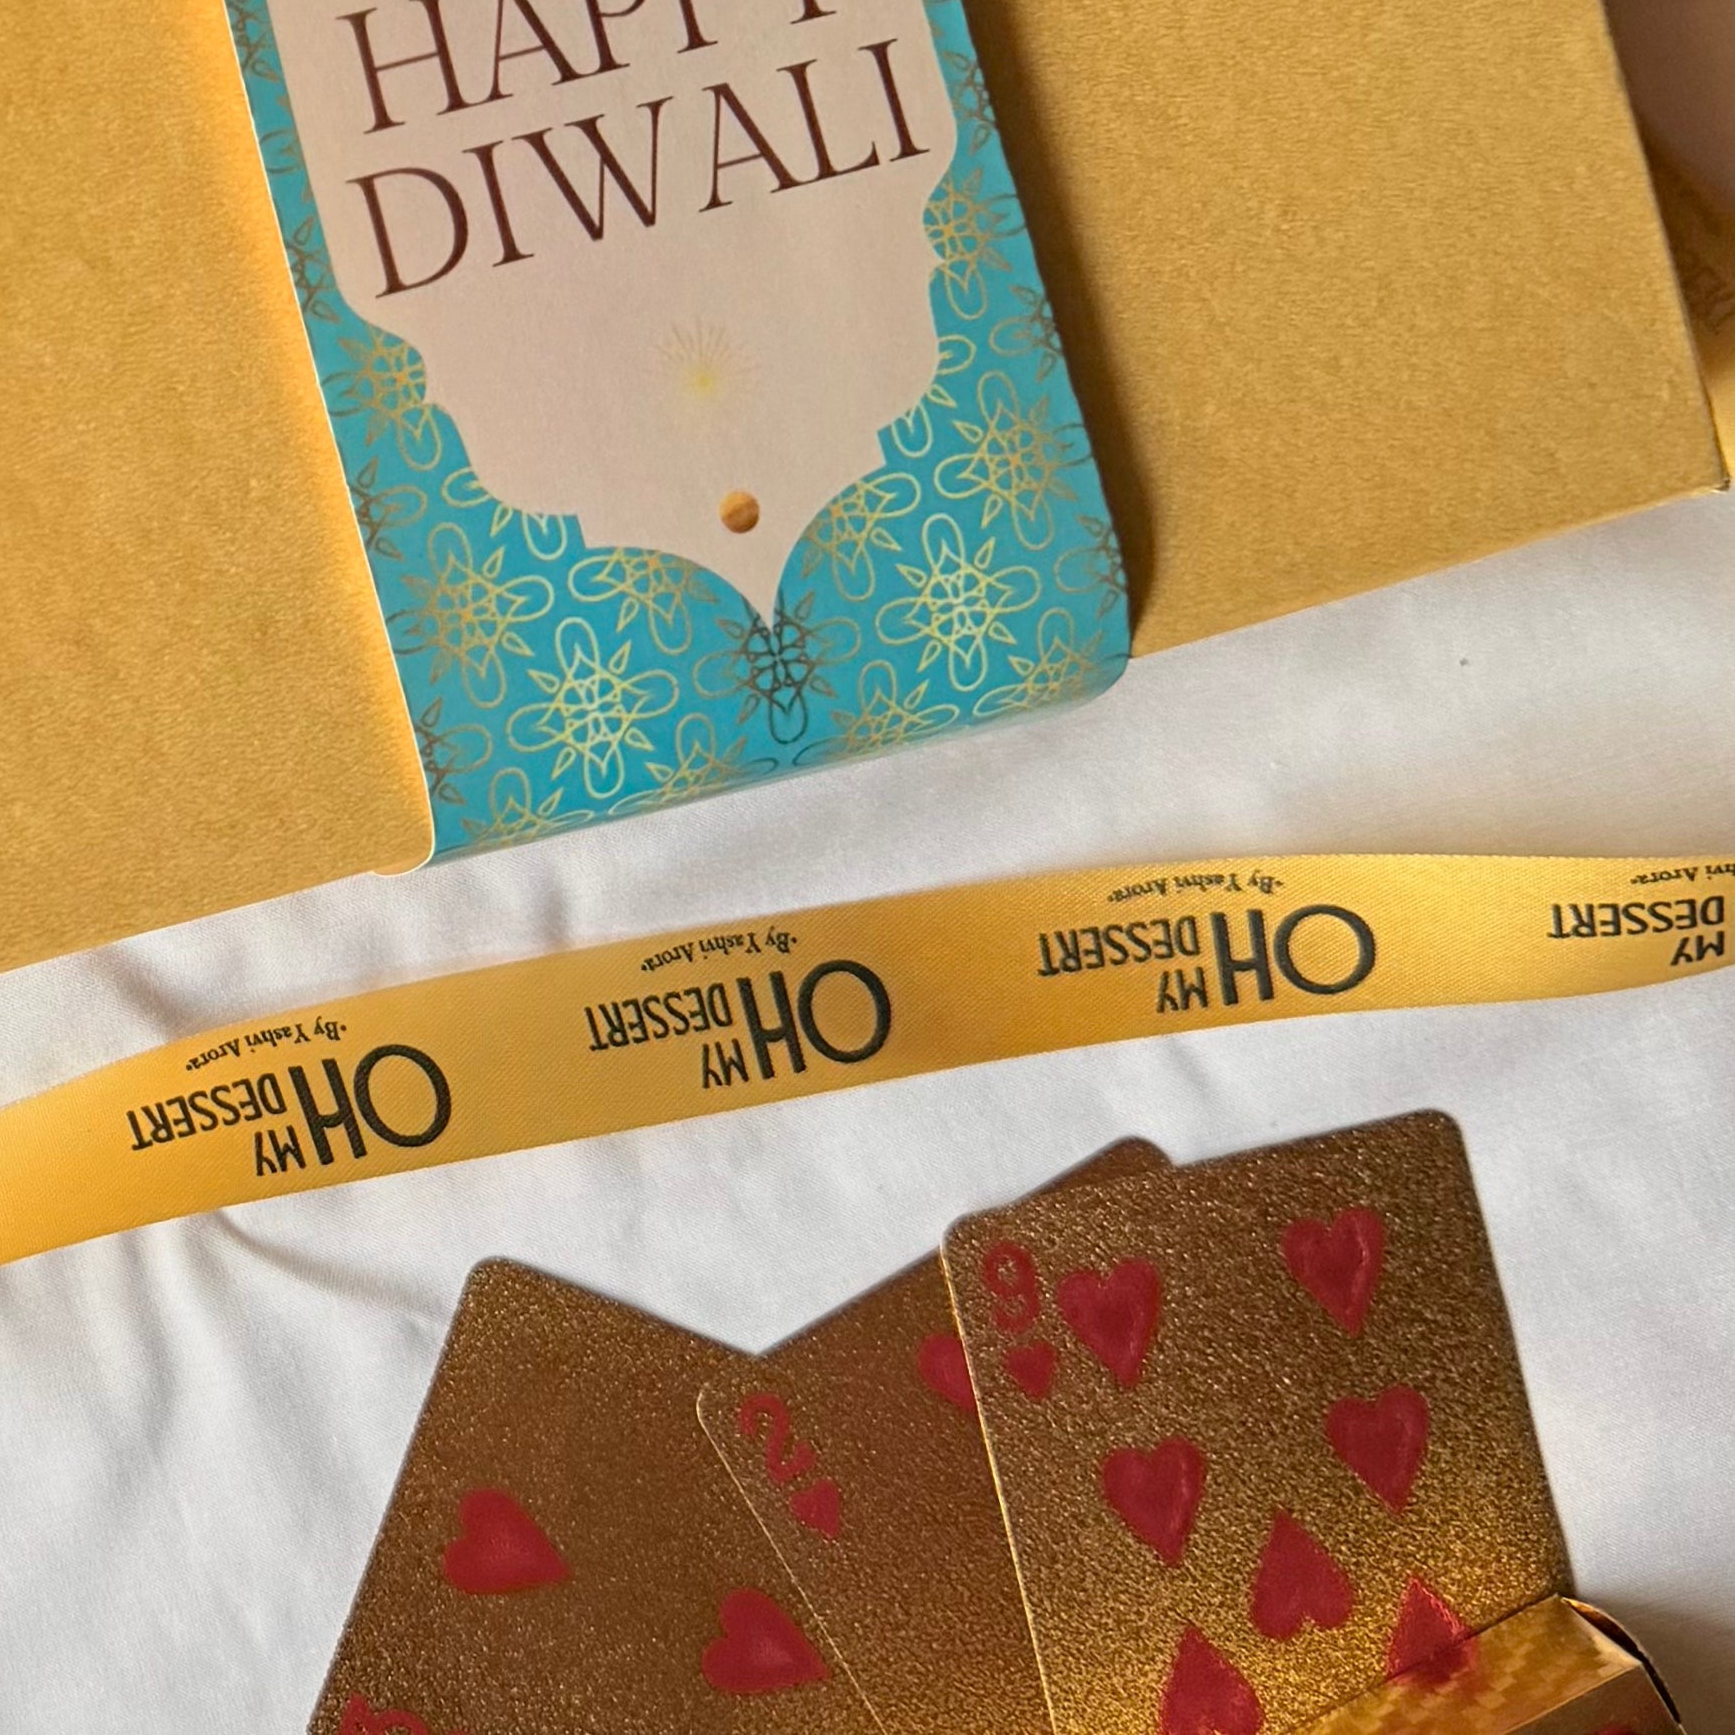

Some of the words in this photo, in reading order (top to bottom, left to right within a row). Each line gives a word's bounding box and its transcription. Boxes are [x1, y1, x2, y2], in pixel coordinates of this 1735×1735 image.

[346, 38, 930, 298] DIWALI
[699, 932, 762, 960] Yashvi
[1037, 915, 1201, 977] DESSERT
[1546, 895, 1725, 939] DESSERT
[1670, 930, 1725, 967] MY
[1210, 904, 1377, 1006] OH
[584, 982, 733, 1052] DESSERT
[736, 959, 891, 1080] OH
[1156, 966, 1209, 1014] MY
[245, 1023, 311, 1053] Yashvi
[701, 1038, 749, 1089] MY
[126, 1072, 288, 1151] DESSERT
[288, 1044, 452, 1166] OH
[254, 1125, 306, 1177] MY
[982, 1241, 1041, 1335] 9
[737, 1392, 816, 1487] 2
